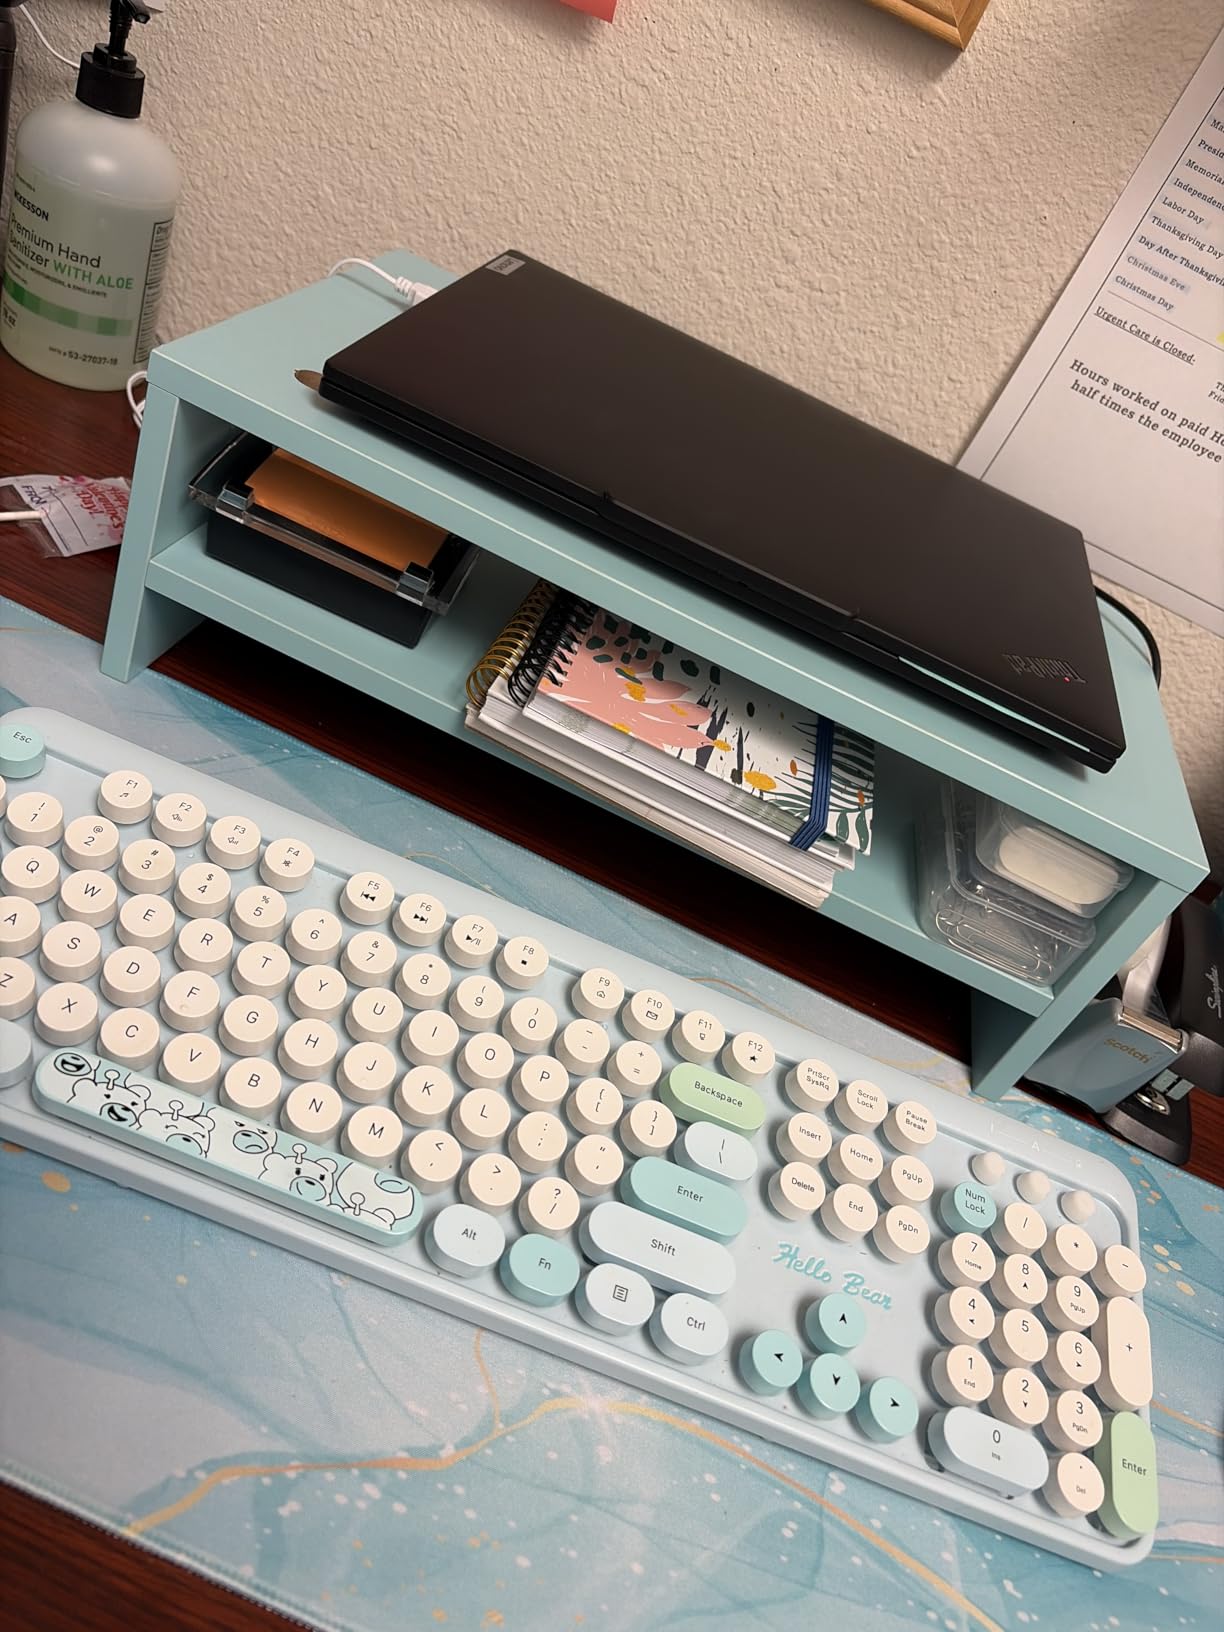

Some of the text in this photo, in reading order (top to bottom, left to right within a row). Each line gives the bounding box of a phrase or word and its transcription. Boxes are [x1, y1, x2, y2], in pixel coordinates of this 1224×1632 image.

[1186, 159, 1224, 185] Memoria
[1162, 197, 1204, 224] Labor Day
[12, 212, 54, 252] Premium
[58, 243, 101, 268] Hand
[1152, 216, 1224, 260] Thanksgiving Day
[1138, 236, 1224, 286] Day After Thanksgivi
[54, 260, 92, 284] WITH
[96, 274, 134, 290] ALOE
[1128, 256, 1185, 290] Christmas Eve
[1116, 276, 1174, 312] Christmas Day
[1096, 306, 1128, 328] Urgent
[1130, 324, 1150, 341] Care
[1152, 336, 1161, 346] is
[1070, 360, 1109, 386] Hours
[1112, 382, 1160, 412] worked
[1161, 408, 1177, 422] on
[1178, 416, 1210, 436] paid
[1071, 380, 1222, 463] half times the employee
[13, 732, 32, 743] Esc
[126, 780, 138, 788] F1
[179, 802, 192, 811] F2
[31, 814, 38, 822] 1
[234, 825, 246, 834] F3
[84, 837, 95, 846] 2
[287, 847, 300, 856] F4
[26, 860, 39, 873] Q
[141, 860, 152, 869] 3
[84, 884, 101, 897] W
[198, 885, 207, 893] 4
[368, 881, 380, 890] F5
[253, 907, 263, 916] 5
[420, 902, 432, 911] F6
[4, 913, 17, 925] A
[143, 909, 155, 921] E
[310, 930, 319, 939] 6
[472, 924, 484, 933] F7
[67, 938, 80, 949] S
[201, 933, 213, 946] R
[523, 945, 534, 954] F8
[262, 956, 272, 968] T
[366, 952, 375, 961] 7
[126, 962, 140, 974] D
[0, 973, 13, 988] Z
[319, 980, 328, 991] Y
[420, 975, 429, 984] 8
[599, 977, 610, 986] F9
[187, 986, 200, 998] F
[62, 998, 78, 1013] X
[475, 997, 483, 1006] 9
[647, 998, 662, 1008] F10
[373, 1003, 385, 1015] U
[247, 1011, 258, 1023] G
[698, 1019, 712, 1030] F11
[126, 1025, 138, 1037] C
[305, 1034, 319, 1048] H
[748, 1040, 763, 1052] F12
[190, 1049, 202, 1062] V
[485, 1049, 495, 1060] O
[366, 1060, 376, 1070] J
[248, 1074, 260, 1087] B
[540, 1071, 550, 1081] P
[807, 1068, 829, 1082] PrtScr
[422, 1082, 434, 1095] K
[807, 1076, 829, 1090] SysRq
[695, 1081, 742, 1107] Backspace
[858, 1090, 878, 1102] Scroll
[309, 1098, 323, 1112] N
[857, 1097, 876, 1109] Lock
[480, 1105, 488, 1118] L
[906, 1111, 927, 1124] Pause
[369, 1123, 384, 1138] M
[906, 1118, 926, 1131] Break
[800, 1126, 821, 1141] Insert
[850, 1148, 873, 1162] Home
[903, 1170, 922, 1184] PgUp
[792, 1178, 814, 1192] Delete
[677, 1186, 703, 1202] Enter
[966, 1189, 985, 1203] Num
[849, 1201, 863, 1212] End
[966, 1200, 985, 1215] Lock
[899, 1220, 918, 1234] PgDn
[462, 1229, 476, 1240] Alt
[651, 1239, 676, 1256] Shift
[972, 1242, 977, 1252] 7
[538, 1258, 551, 1270] Fn
[965, 1259, 982, 1270] Home
[1022, 1264, 1029, 1275] 8
[772, 1241, 892, 1310] Hello Bear
[1074, 1286, 1080, 1297] 9
[968, 1299, 975, 1310] 4
[1070, 1302, 1085, 1313] PgUp
[687, 1317, 705, 1330] Ctrl
[1022, 1320, 1029, 1332] 5
[1075, 1342, 1082, 1354] 6
[968, 1358, 972, 1369] 1
[964, 1379, 975, 1388] End
[1022, 1380, 1029, 1392] 2
[1076, 1402, 1083, 1414] 3
[1073, 1423, 1088, 1433] PgDn
[1122, 1459, 1146, 1476] Enter
[1076, 1485, 1086, 1494] Del
